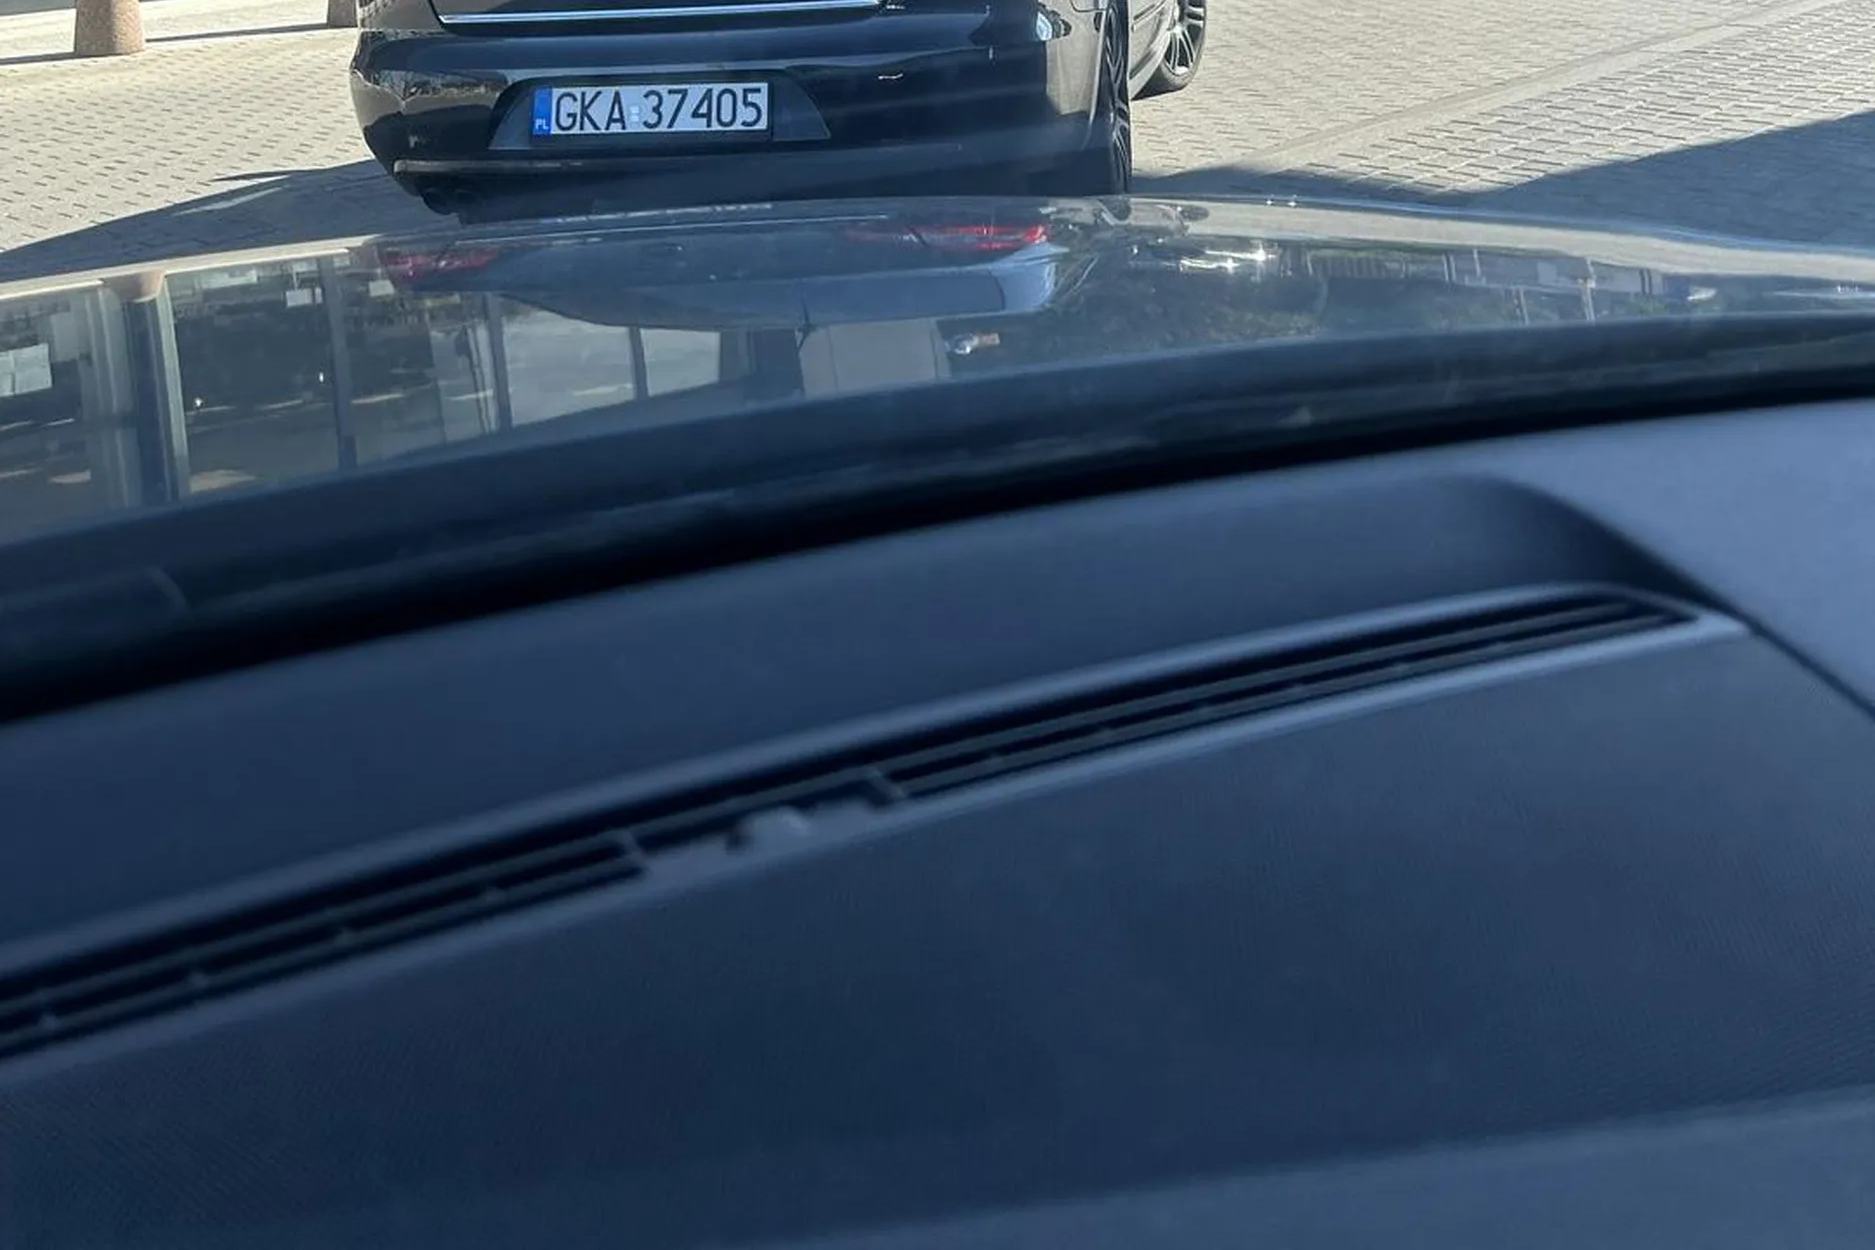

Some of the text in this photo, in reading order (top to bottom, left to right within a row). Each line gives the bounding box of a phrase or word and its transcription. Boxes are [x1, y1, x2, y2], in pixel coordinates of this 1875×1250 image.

[535, 88, 762, 131] PL GKA 37405
